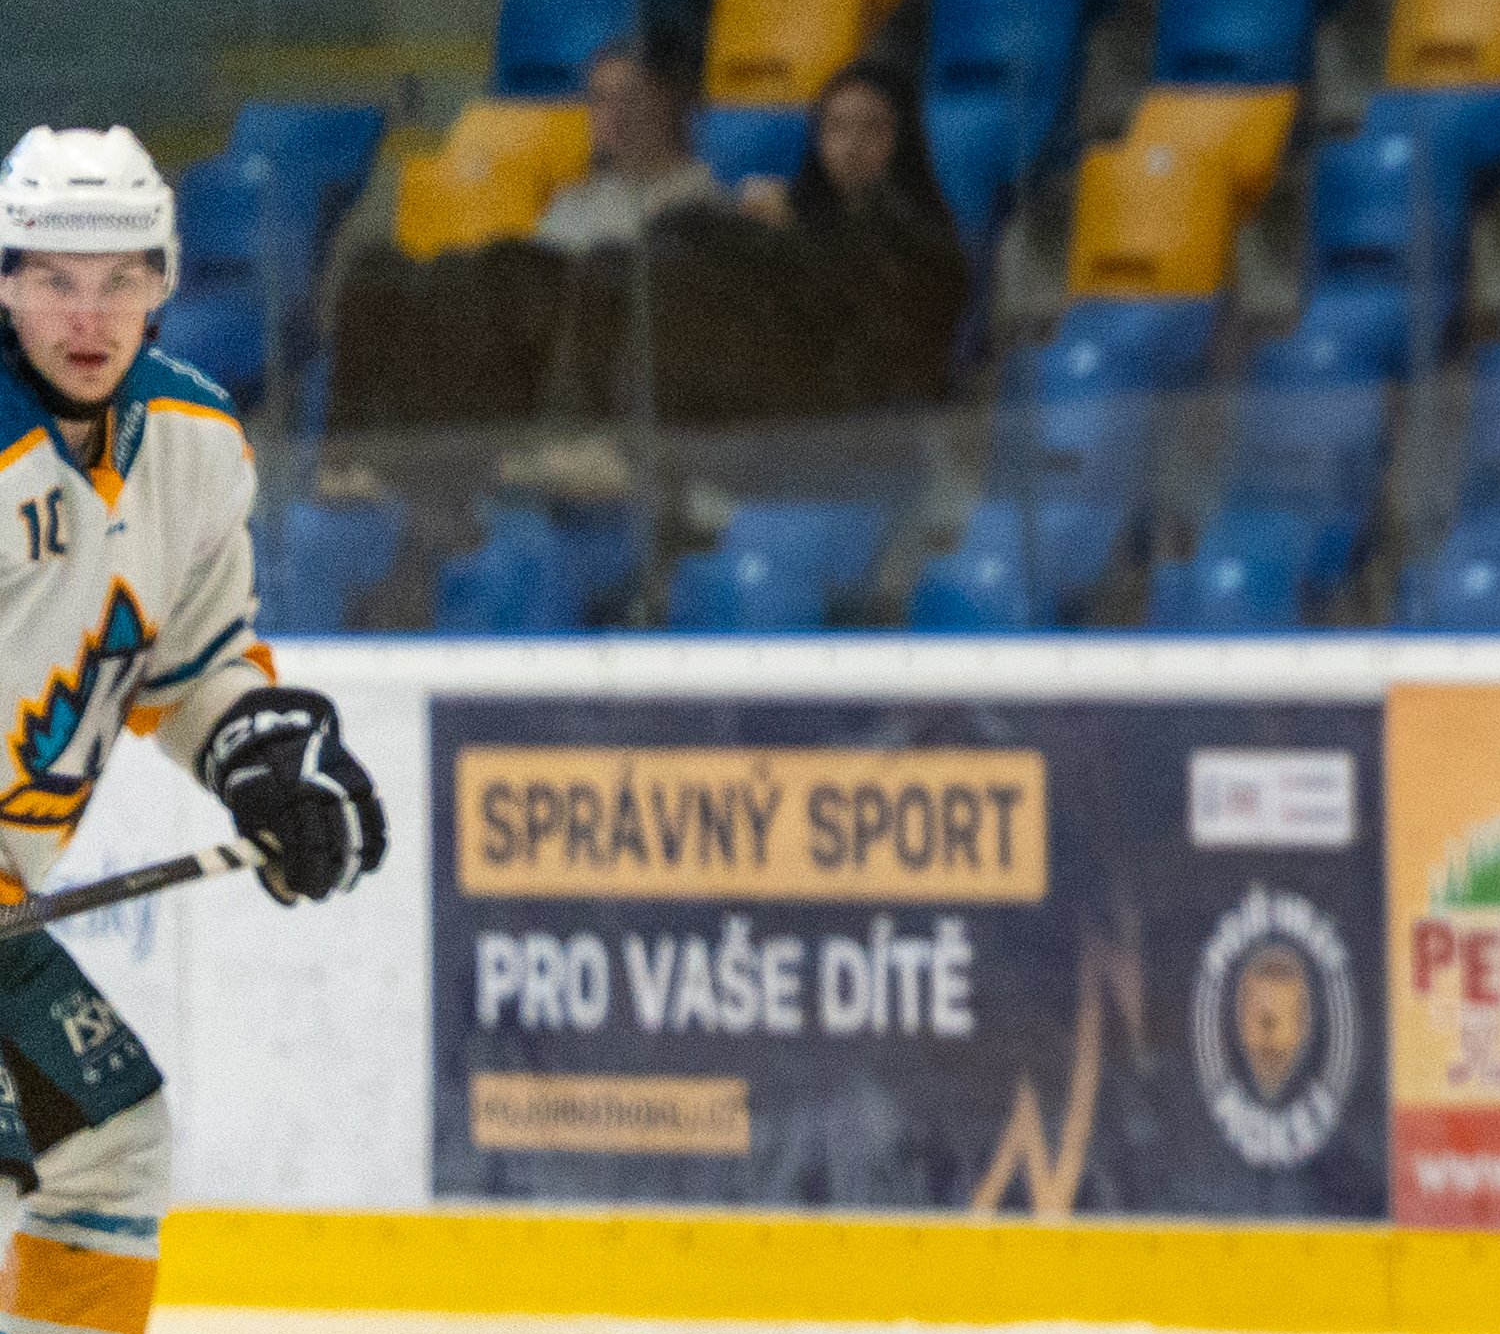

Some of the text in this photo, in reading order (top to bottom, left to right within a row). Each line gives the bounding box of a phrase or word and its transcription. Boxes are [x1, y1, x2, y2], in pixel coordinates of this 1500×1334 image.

[480, 759, 1025, 873] SPRÁVNÝ SPORT
[475, 913, 977, 1038] PRO VAŠE DÍTĚ
